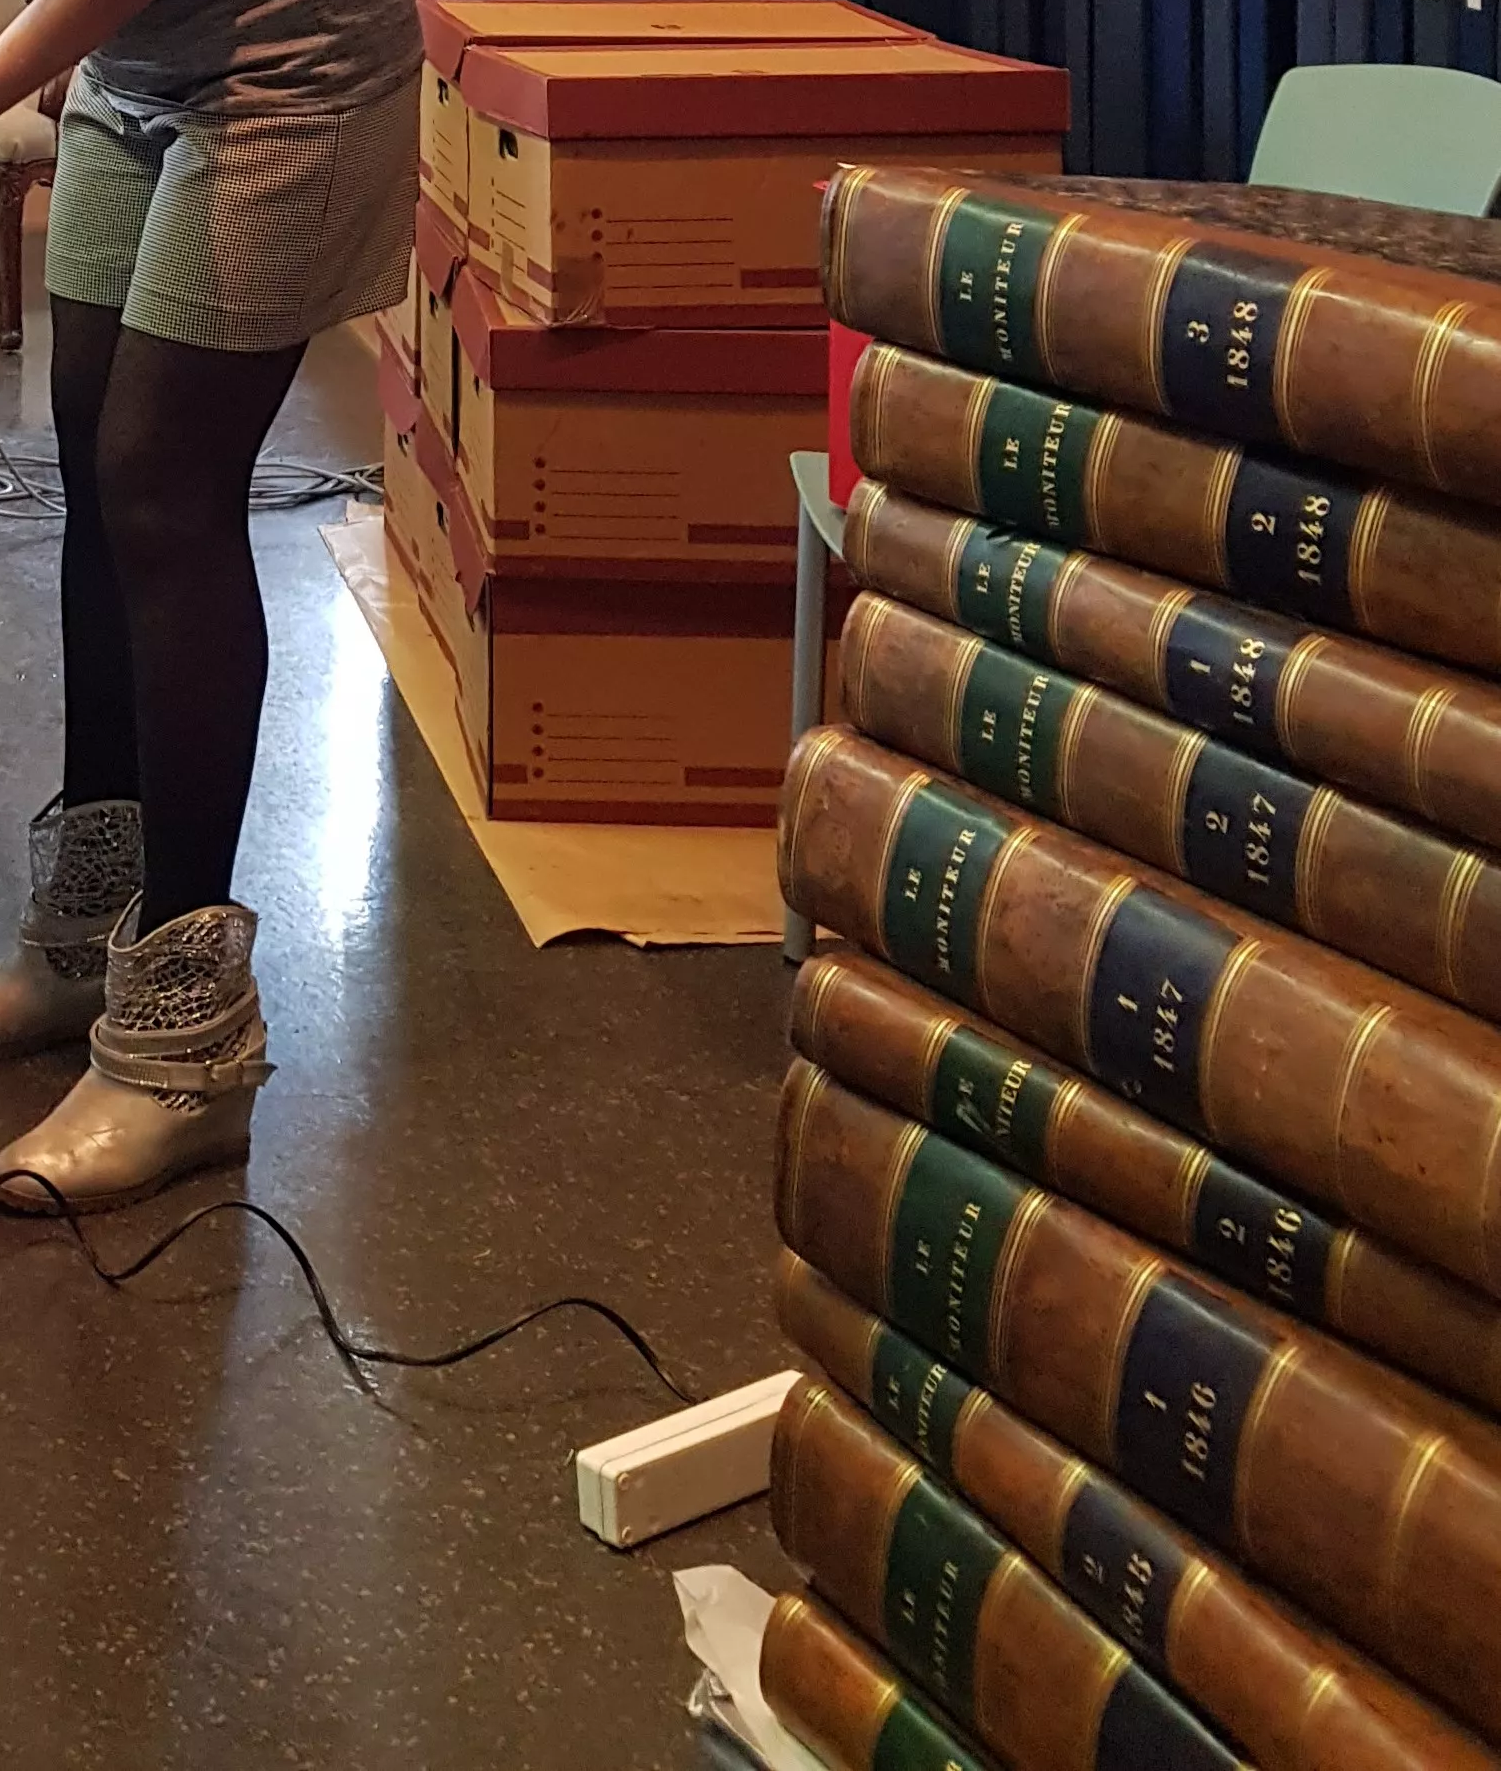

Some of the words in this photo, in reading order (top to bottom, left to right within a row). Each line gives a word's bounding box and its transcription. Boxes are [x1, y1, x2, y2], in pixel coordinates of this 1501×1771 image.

[959, 271, 974, 302] LE
[993, 222, 1025, 362] MONITEUR
[1187, 321, 1210, 343] 3
[1226, 301, 1258, 386] 1848
[1003, 437, 1020, 469] LE
[1042, 404, 1073, 526] MONITEUR
[1251, 513, 1276, 536] 2
[1297, 495, 1331, 585] 1848
[976, 562, 991, 594] LE
[1190, 659, 1211, 674] 1
[1230, 638, 1265, 724] 1848
[982, 709, 997, 742] LE
[1018, 675, 1050, 800] MONITEUR
[1205, 811, 1229, 835] 2
[1246, 792, 1276, 885] 1847
[905, 868, 922, 902] LE
[936, 829, 977, 971] MONITEUR
[1117, 993, 1138, 1013] 1
[1153, 977, 1183, 1072] 1847
[1218, 1217, 1246, 1245] 2
[915, 1239, 930, 1275] LE
[1266, 1208, 1302, 1302] 1846
[1144, 1390, 1167, 1412] 1
[1181, 1381, 1216, 1481] 1846
[1121, 1553, 1152, 1641] 845
